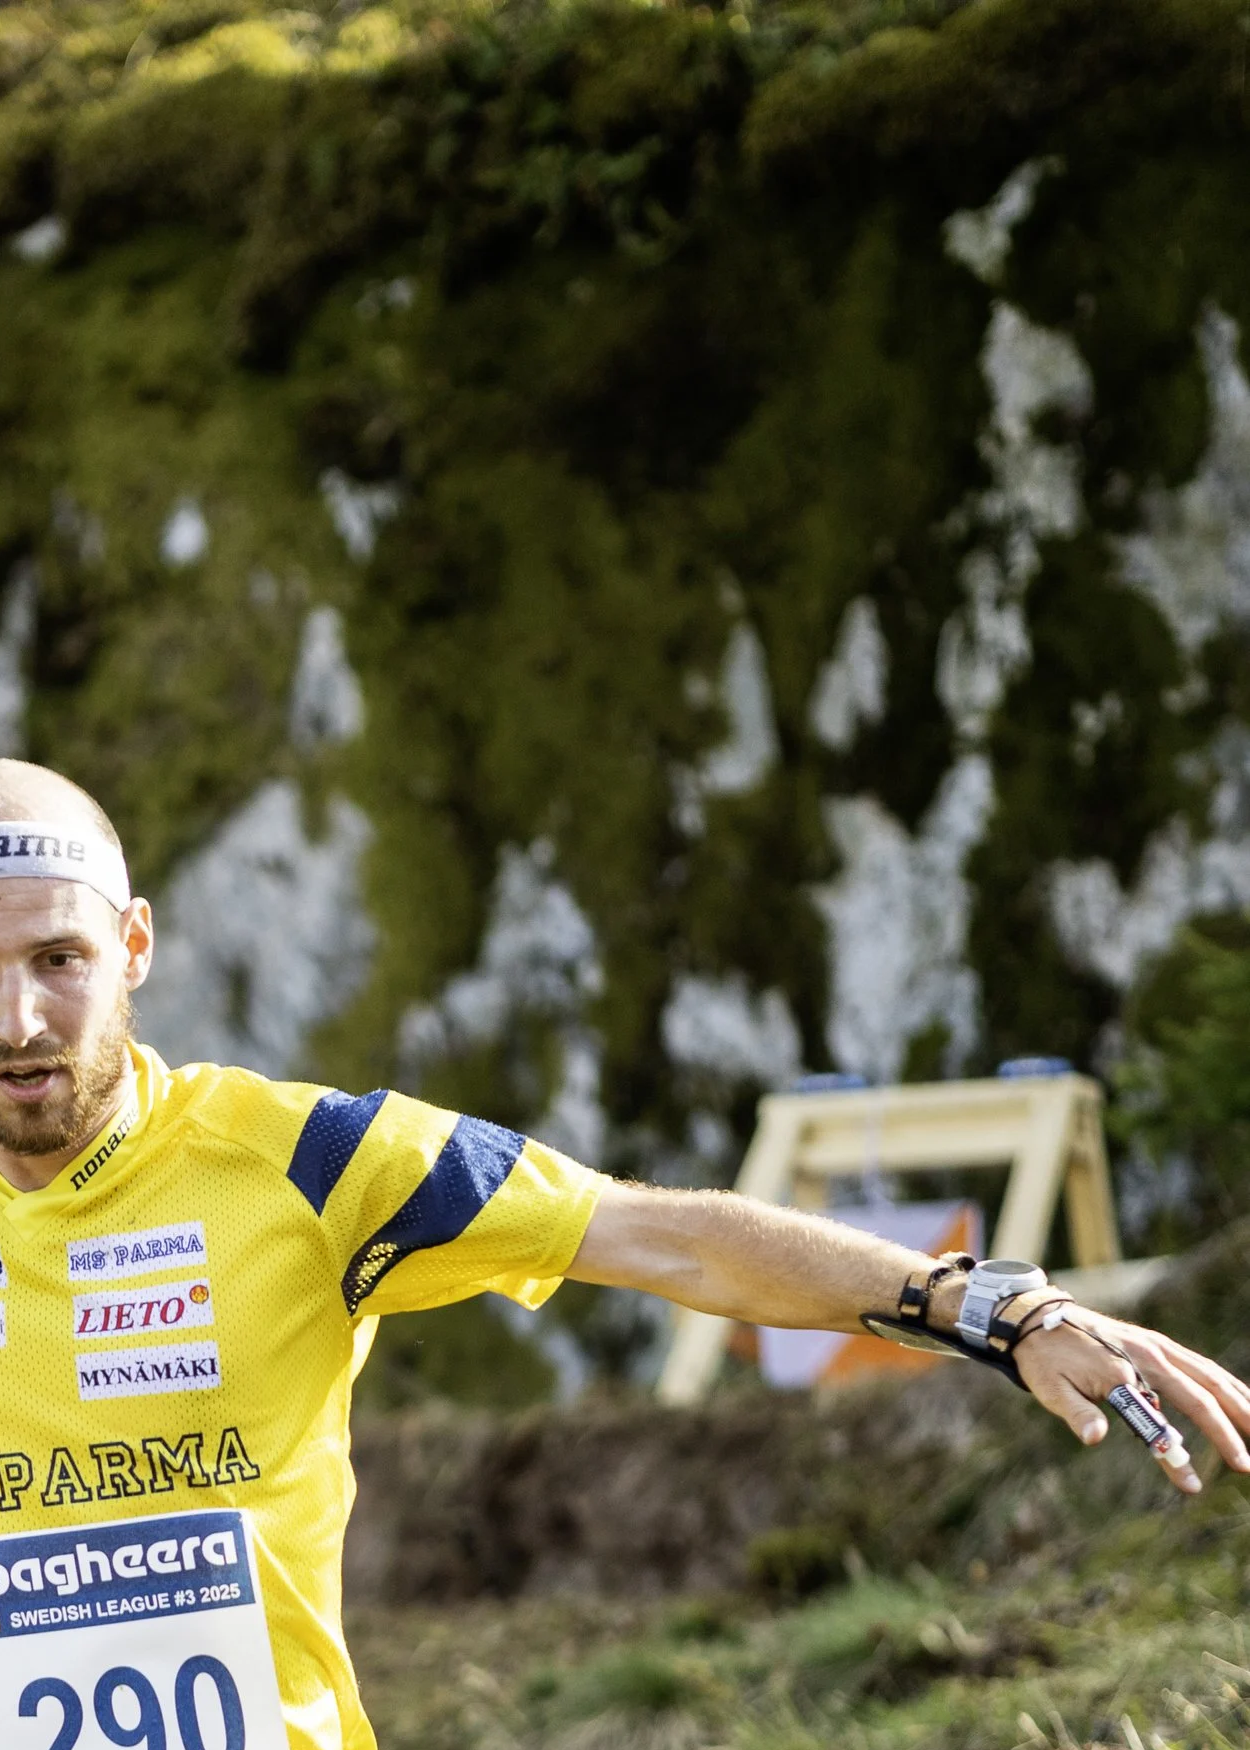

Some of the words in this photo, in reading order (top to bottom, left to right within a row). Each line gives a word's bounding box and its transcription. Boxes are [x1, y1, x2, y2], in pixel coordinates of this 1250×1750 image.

[70, 1250, 107, 1273] MS
[116, 1234, 204, 1267] PARMA
[75, 1297, 186, 1335] LIETO
[79, 1357, 218, 1389] MYNÄMÄKI
[10, 1604, 92, 1629] SWEDISH
[97, 1594, 170, 1619] LEAGUE
[174, 1588, 196, 1607] #3
[199, 1583, 241, 1604] 2025
